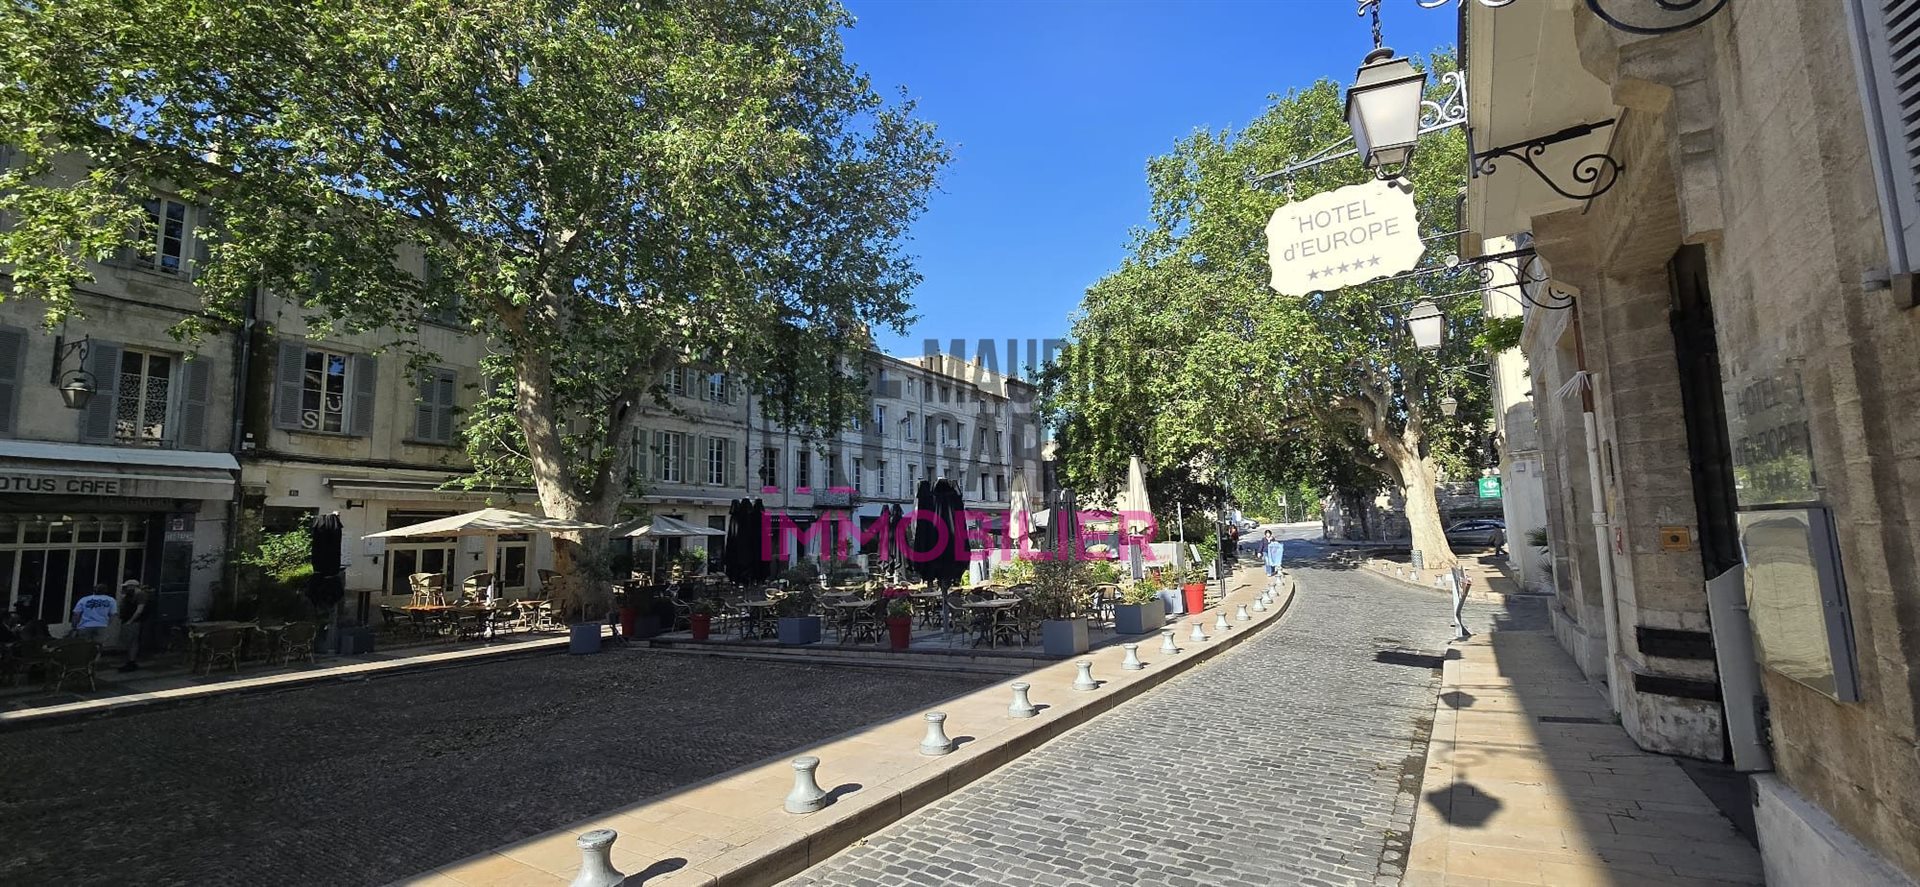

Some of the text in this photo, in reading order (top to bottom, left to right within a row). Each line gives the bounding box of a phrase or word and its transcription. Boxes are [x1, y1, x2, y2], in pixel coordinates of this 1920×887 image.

[1299, 200, 1375, 233] HOTEL
[1284, 217, 1400, 262] d'EUROPE
[66, 479, 118, 494] CAFE
